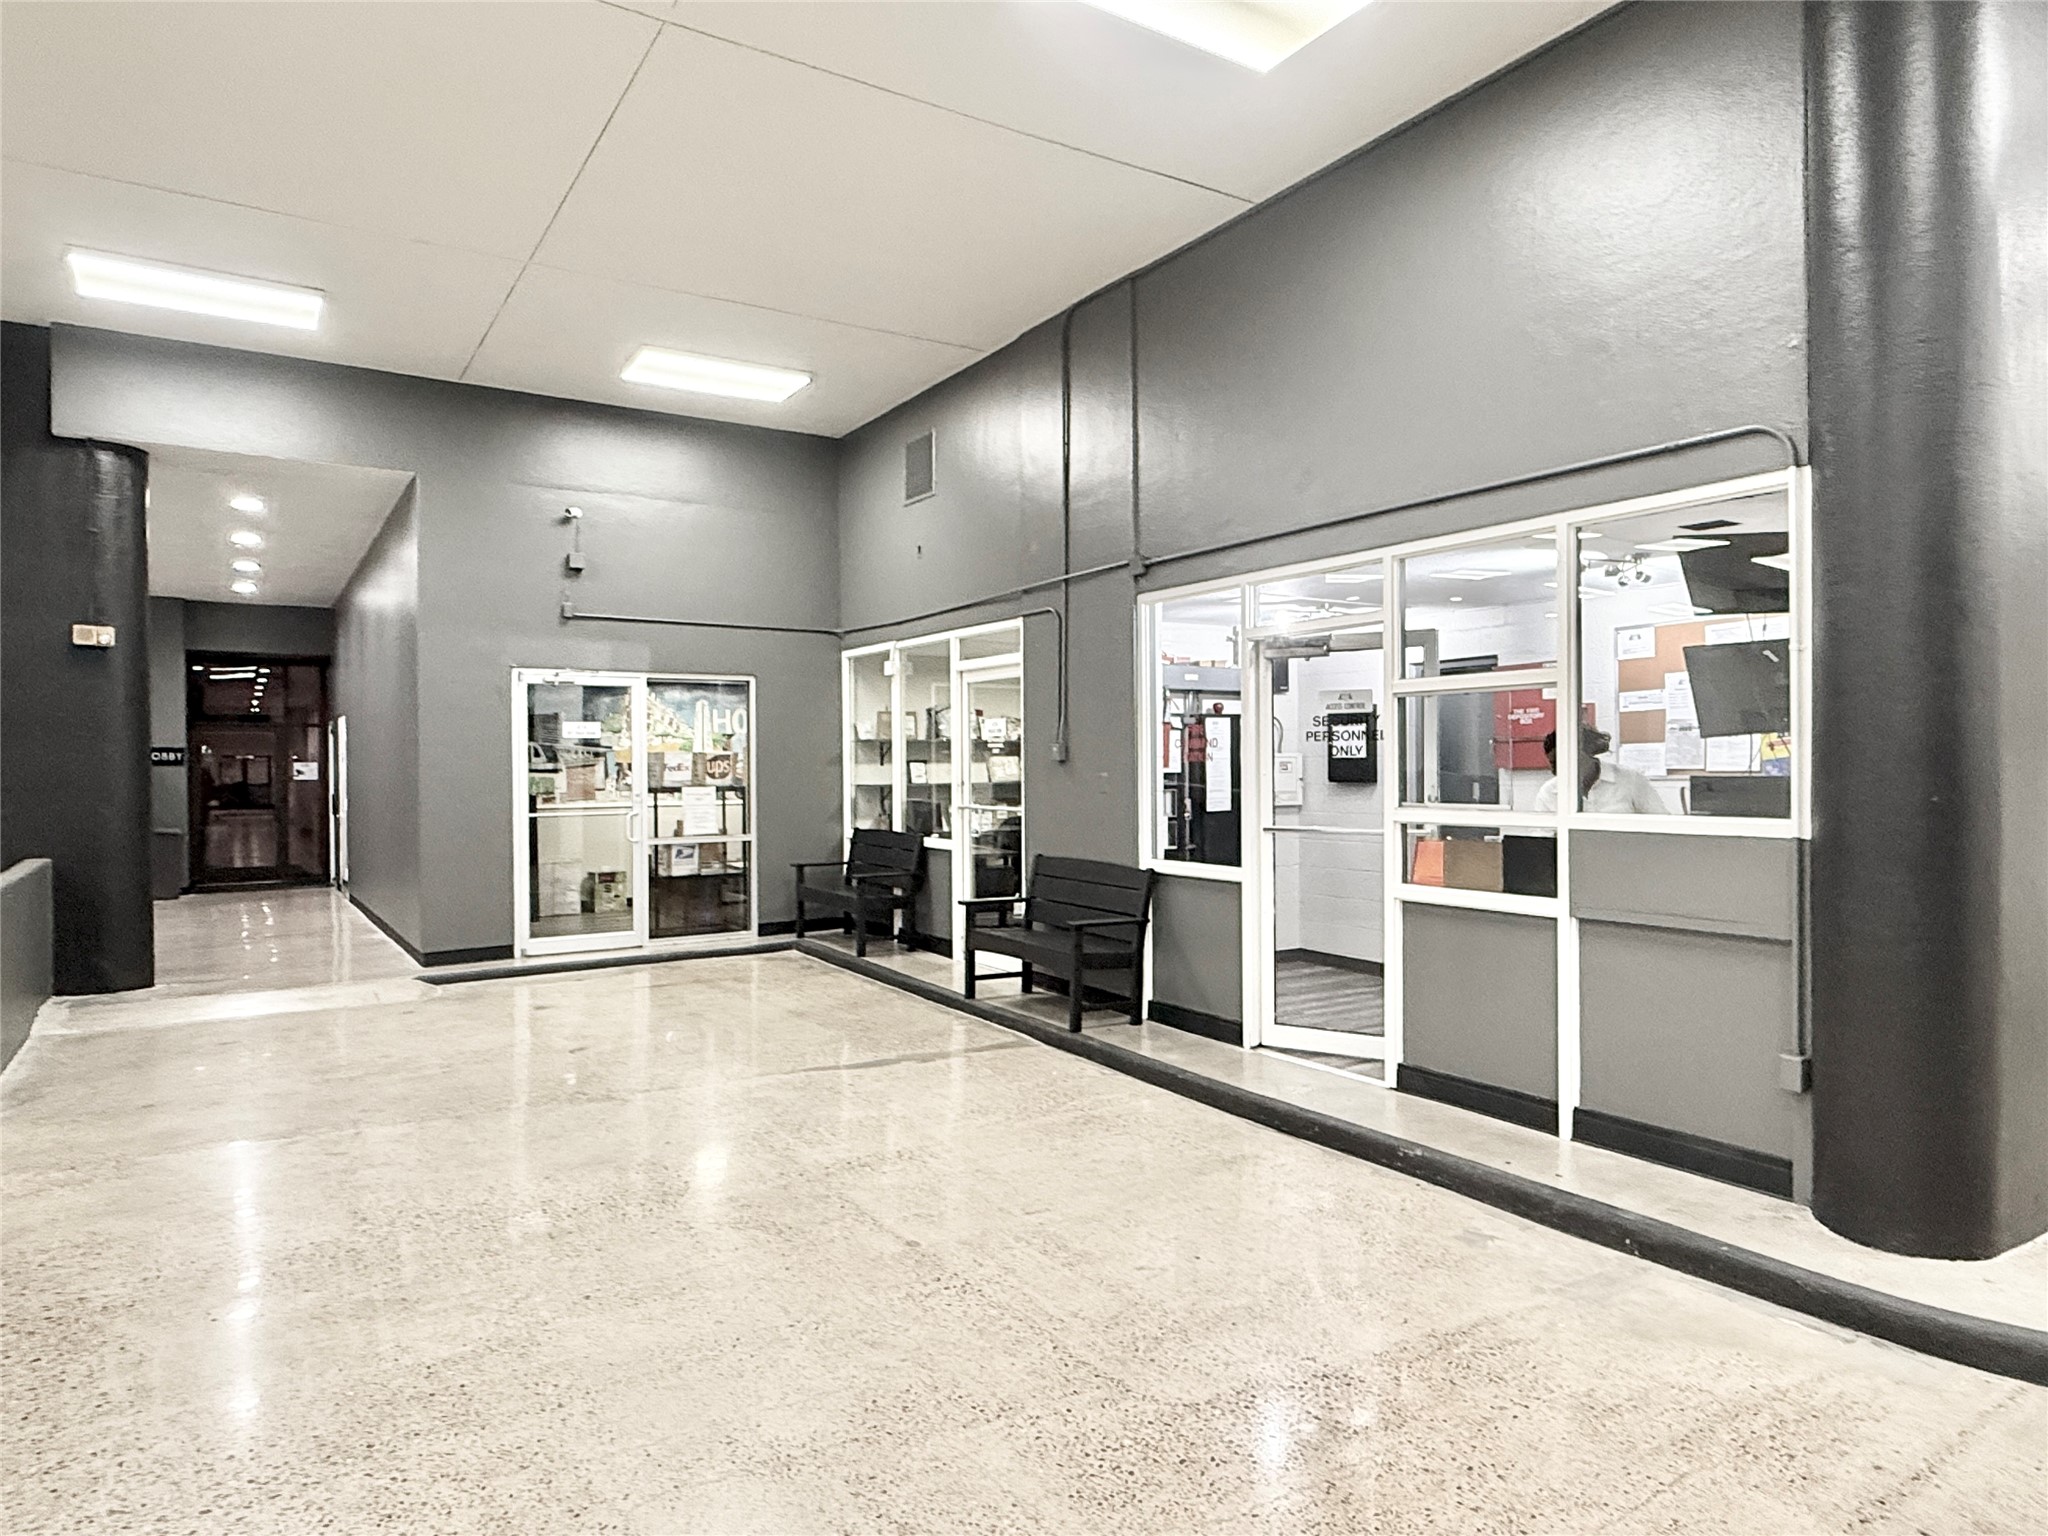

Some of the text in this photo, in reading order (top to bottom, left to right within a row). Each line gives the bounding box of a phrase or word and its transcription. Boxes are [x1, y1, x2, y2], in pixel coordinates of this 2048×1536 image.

[151, 752, 183, 761] OBBY
[1330, 744, 1364, 757] ONLY
[707, 760, 730, 778] ups
